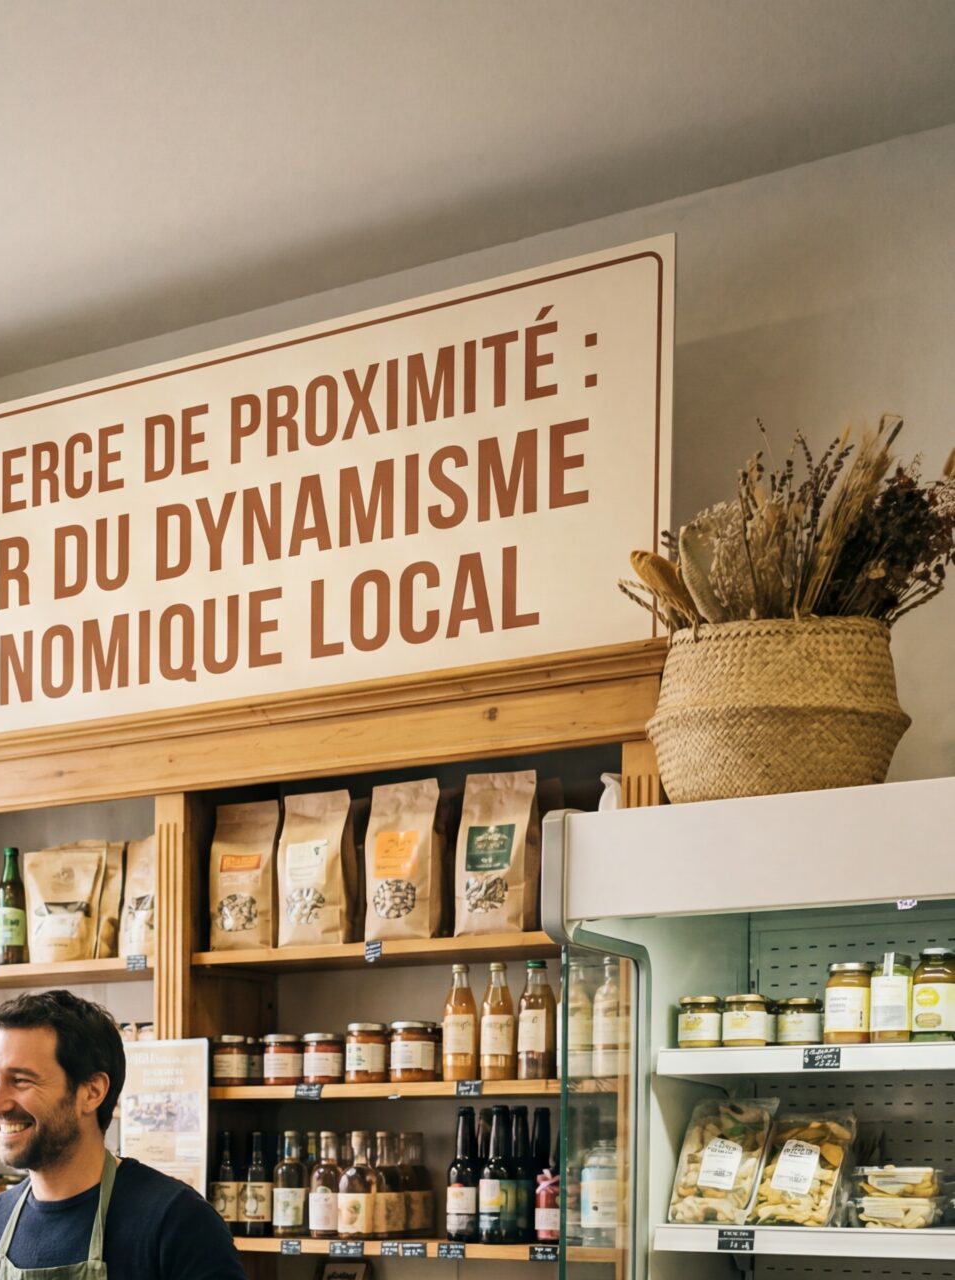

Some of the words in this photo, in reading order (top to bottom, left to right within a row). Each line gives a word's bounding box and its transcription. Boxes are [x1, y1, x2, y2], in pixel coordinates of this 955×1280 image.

[144, 404, 209, 483] DE
[230, 304, 559, 466] PROXIMITÉ
[584, 332, 598, 389] :
[54, 514, 130, 600] DU
[155, 418, 590, 582] DYNAMISME
[310, 546, 540, 659] LOCAL
